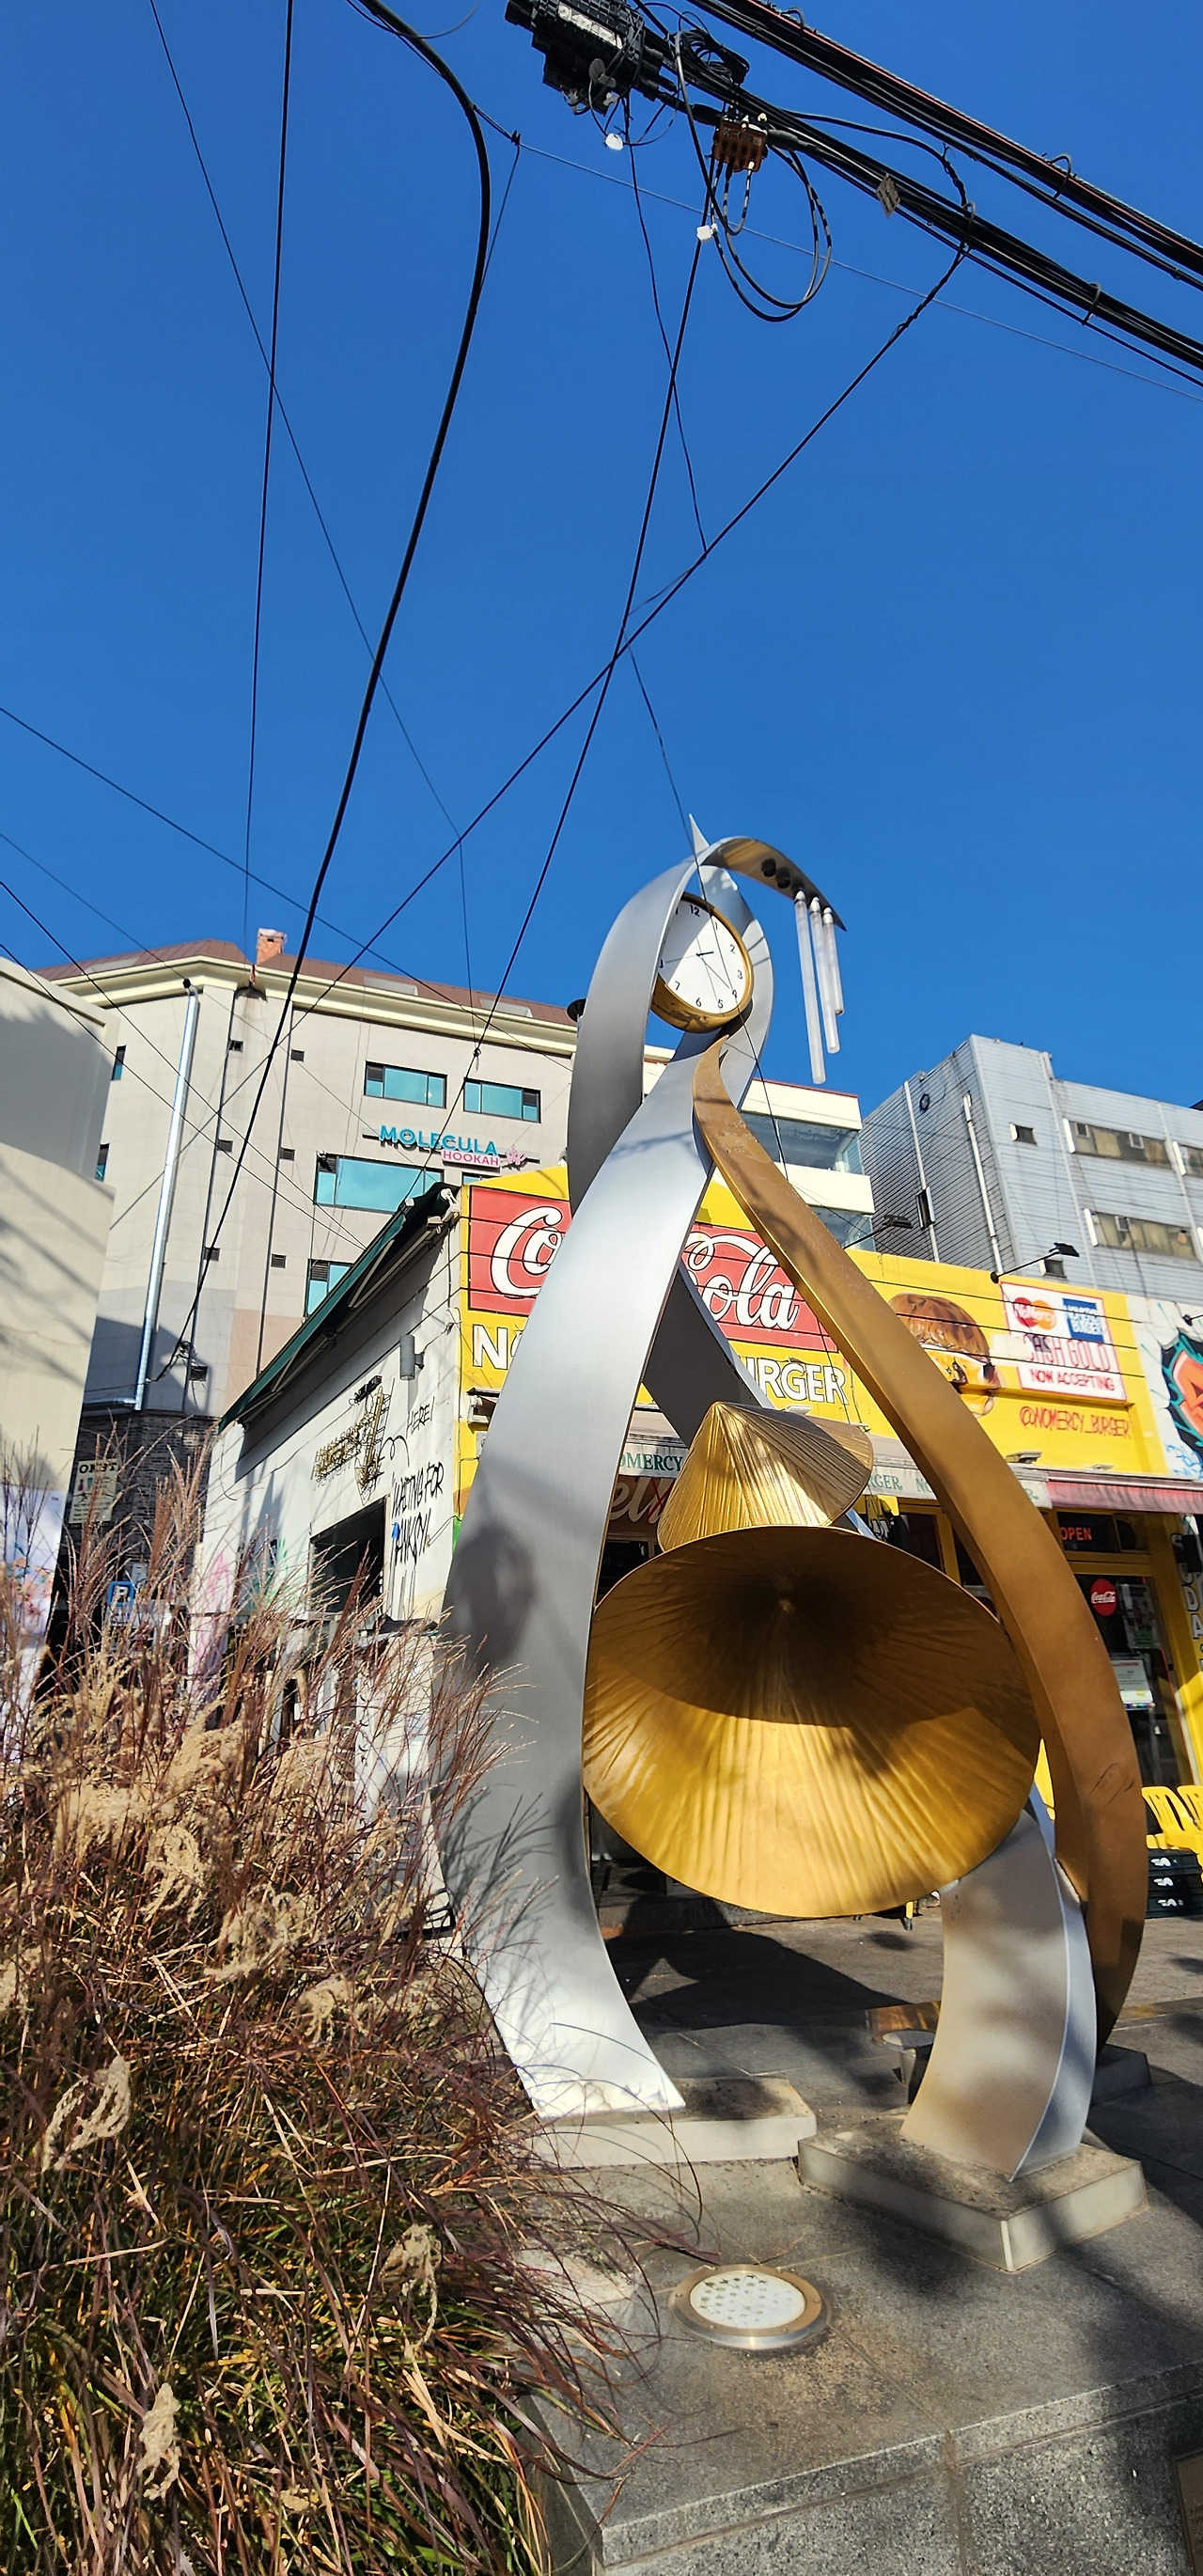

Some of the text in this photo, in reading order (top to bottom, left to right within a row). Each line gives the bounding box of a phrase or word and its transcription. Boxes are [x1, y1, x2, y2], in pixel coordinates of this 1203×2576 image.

[690, 904, 700, 917] 12
[729, 944, 736, 953] 2
[737, 969, 743, 980] 3
[674, 981, 680, 991] 7
[695, 997, 702, 1008] 6
[717, 999, 724, 1009] 5
[380, 1124, 499, 1156] MOLECULA
[443, 1151, 499, 1166] HOOKAH
[1067, 1338, 1111, 1372] GOLD
[1030, 1369, 1116, 1391] NOW ACCEPTING
[1020, 1406, 1132, 1439] @NOMERCY_BURGER
[425, 1461, 444, 1503] FOR
[1060, 1527, 1092, 1542] OPEN
